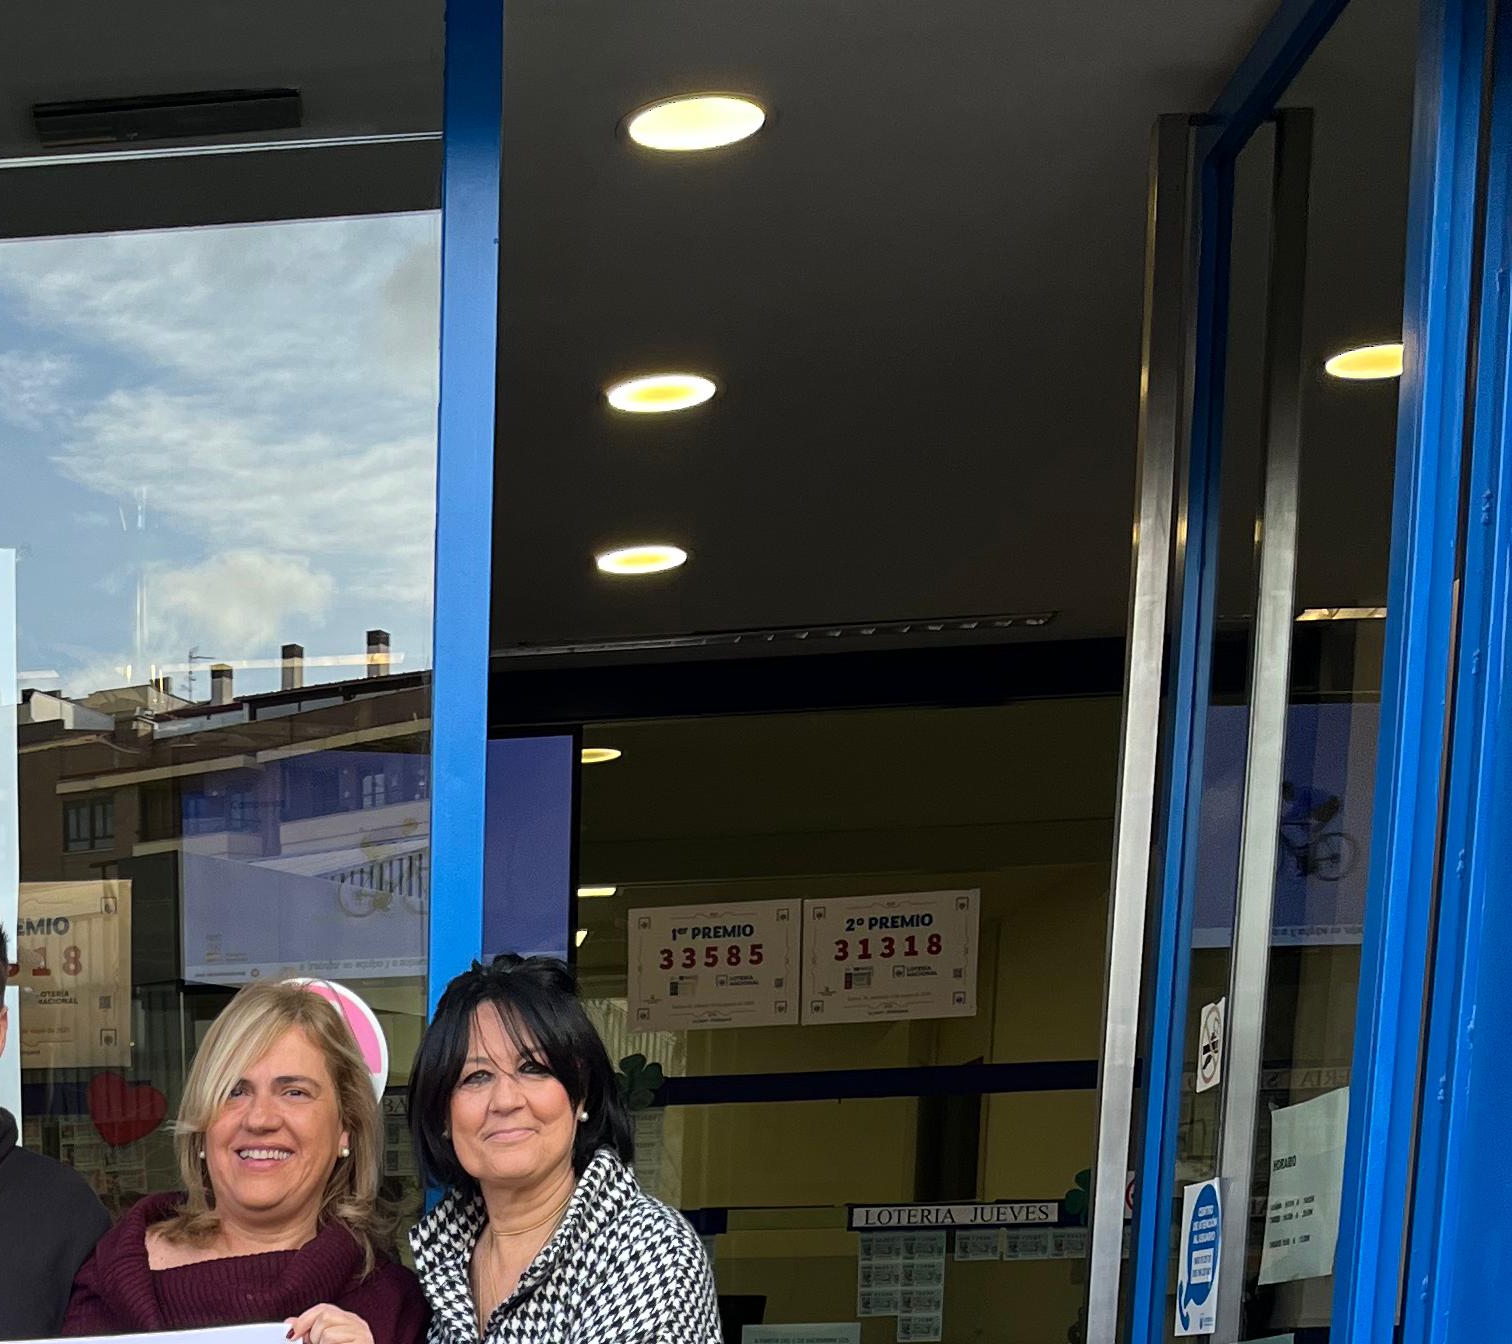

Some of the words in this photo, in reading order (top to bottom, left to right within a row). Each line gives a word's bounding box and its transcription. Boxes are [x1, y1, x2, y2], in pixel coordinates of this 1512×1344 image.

[691, 923, 755, 940] PREMIO
[868, 912, 934, 930] PREMIO
[659, 943, 764, 970] 33585
[834, 933, 943, 962] 31318
[864, 1207, 957, 1226] LOTERIA
[969, 1204, 1051, 1224] JUEVES
